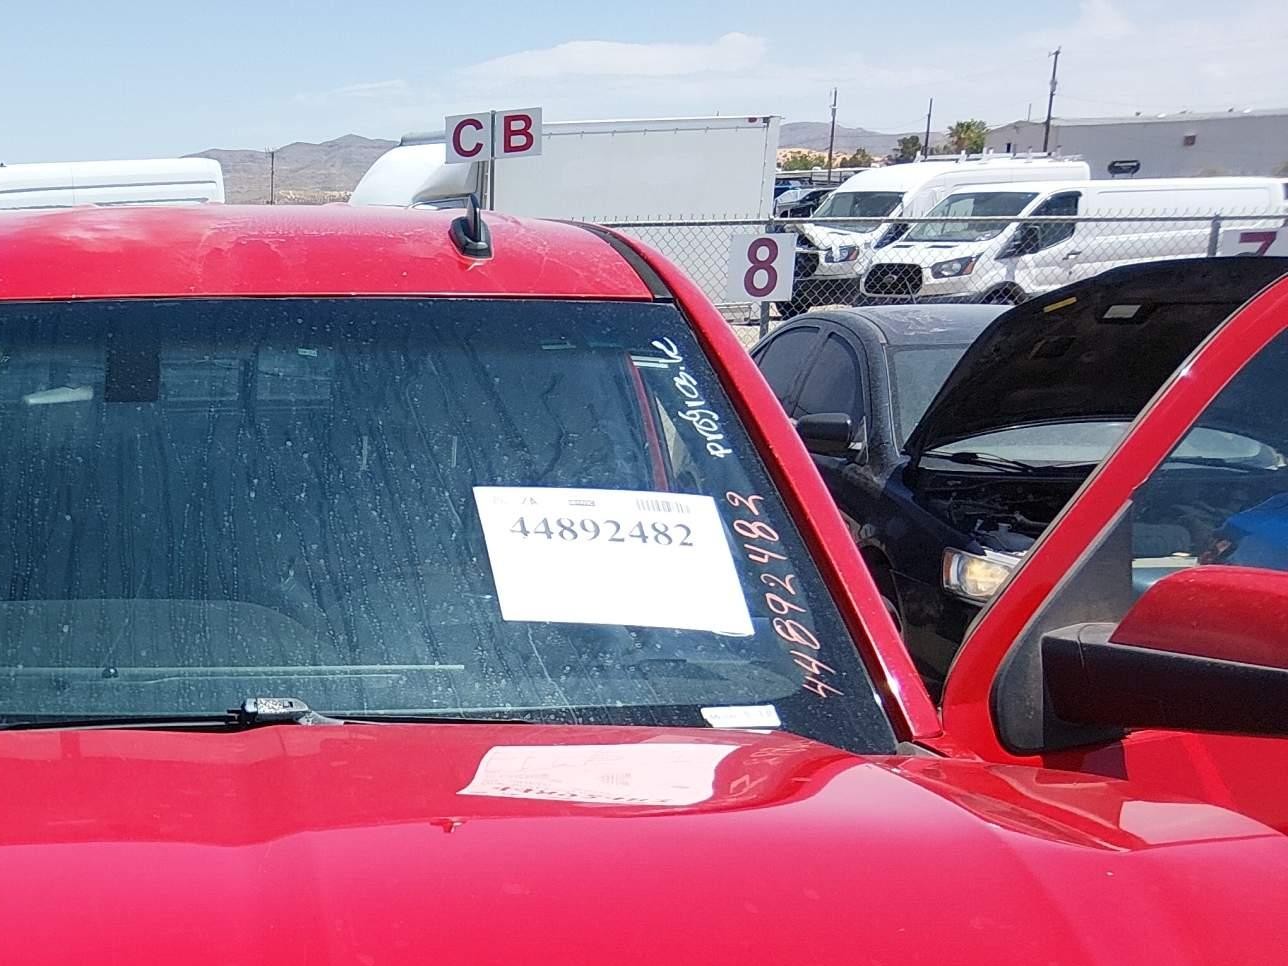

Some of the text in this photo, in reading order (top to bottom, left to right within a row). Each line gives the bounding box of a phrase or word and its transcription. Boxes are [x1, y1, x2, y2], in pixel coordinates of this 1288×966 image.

[453, 118, 483, 157] C
[503, 114, 534, 153] B
[744, 237, 778, 297] 8
[510, 517, 694, 546] 44892482
[726, 491, 844, 698] 44892482
